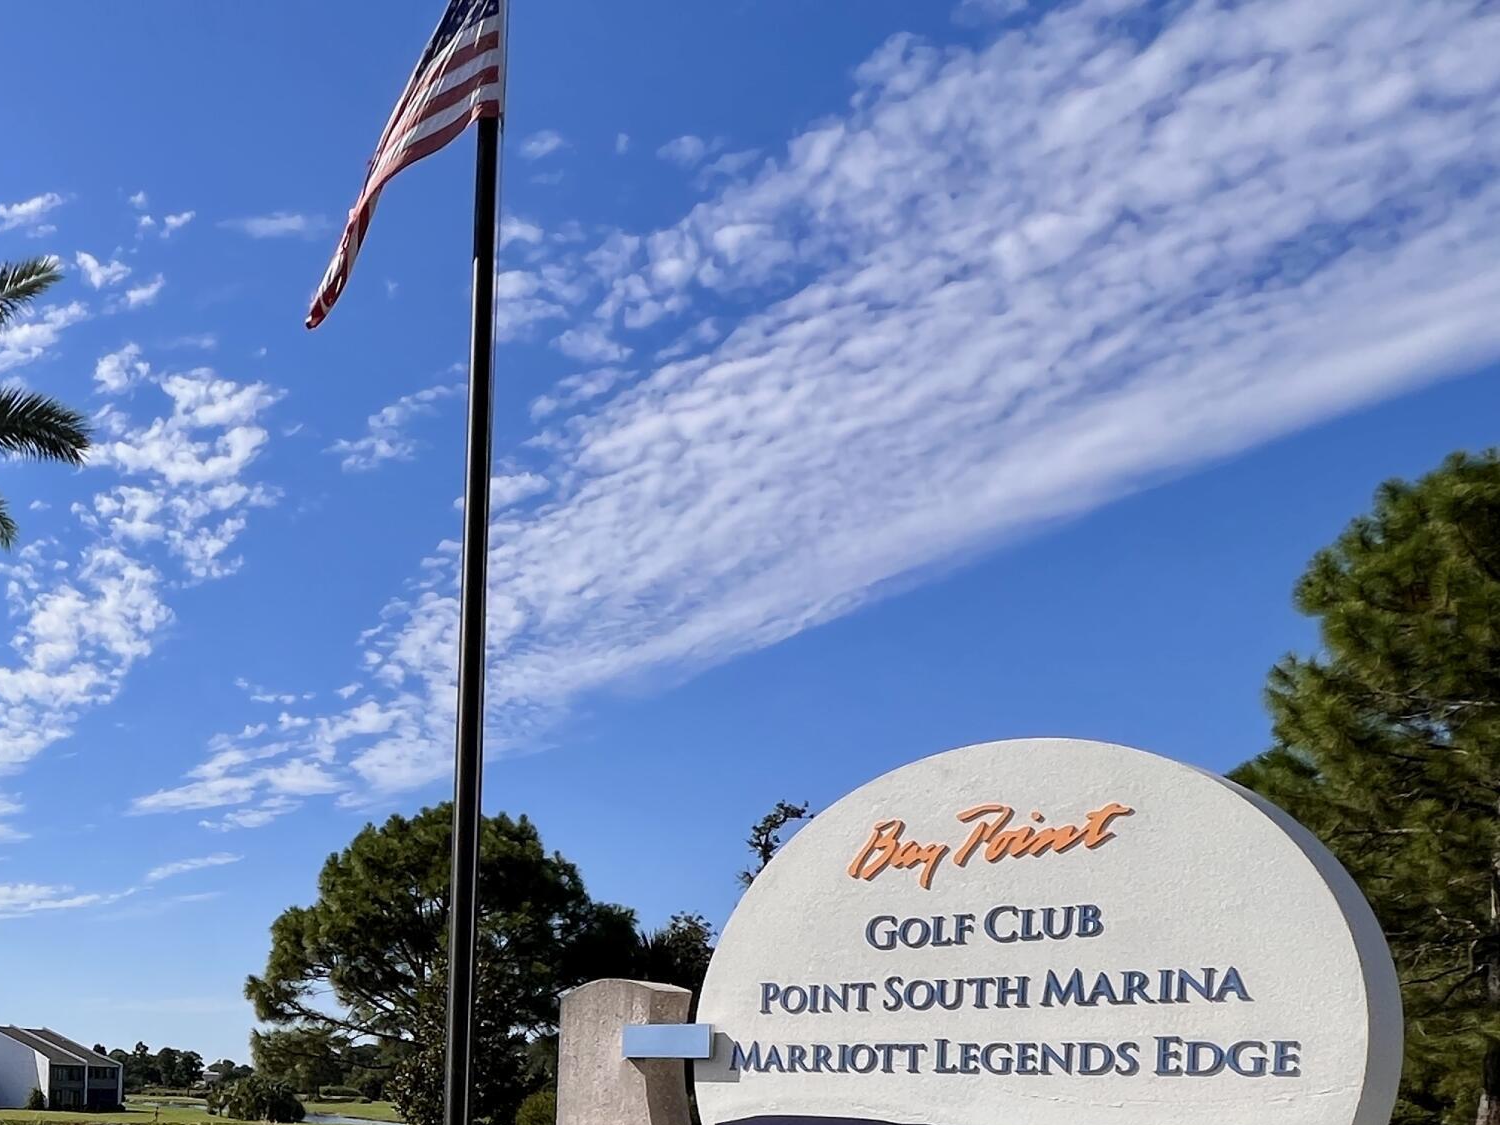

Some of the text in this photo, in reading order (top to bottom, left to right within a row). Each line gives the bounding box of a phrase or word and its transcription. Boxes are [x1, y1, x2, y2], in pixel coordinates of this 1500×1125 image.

[847, 802, 1134, 889] Bay Point
[866, 904, 1104, 950] GOLF CLUB
[760, 966, 1254, 1014] POINT SOUTH MARINA
[730, 1035, 1301, 1078] MARRIOTT LEGENDS EDGE
